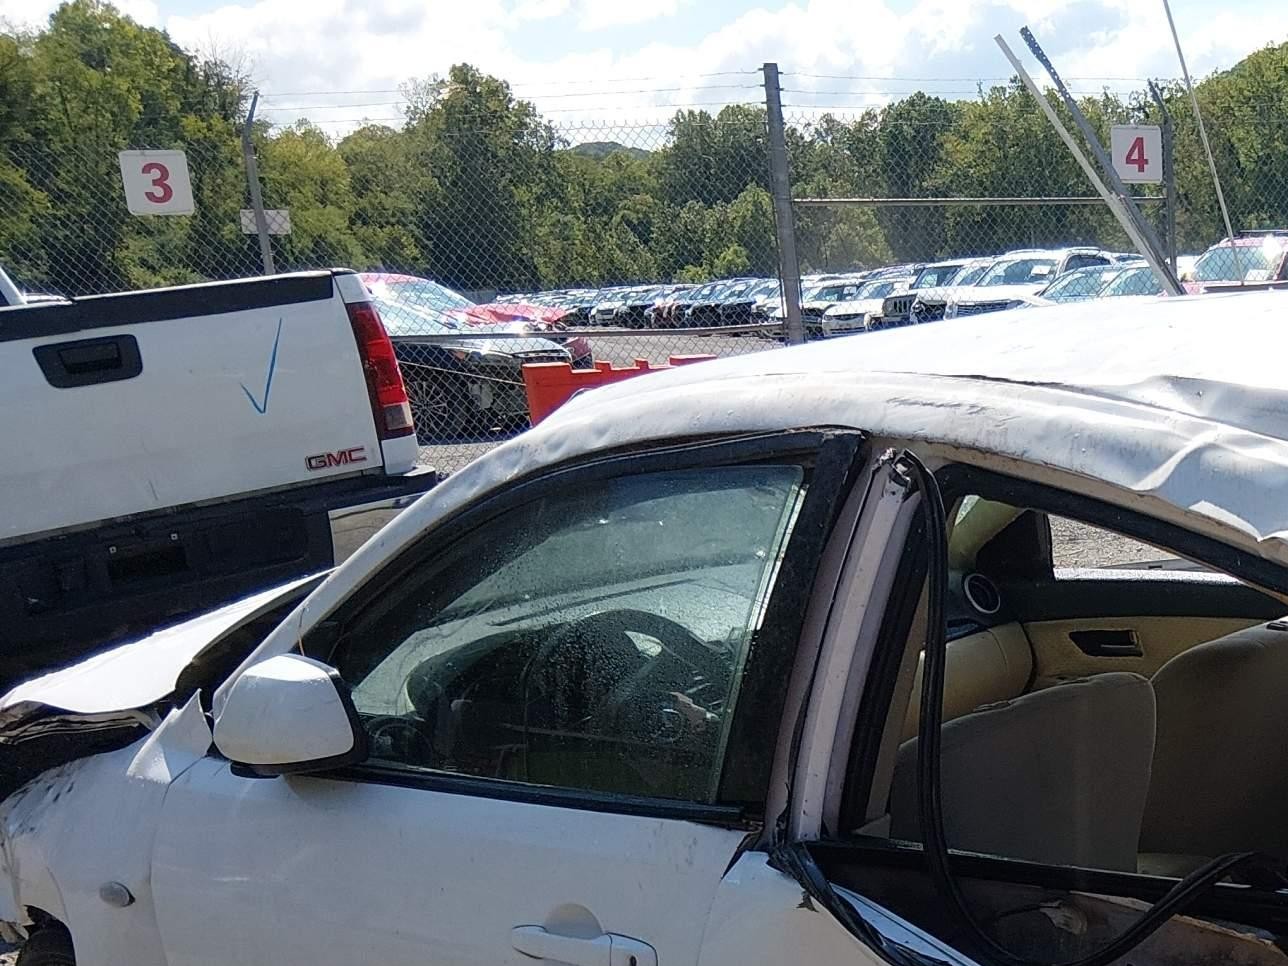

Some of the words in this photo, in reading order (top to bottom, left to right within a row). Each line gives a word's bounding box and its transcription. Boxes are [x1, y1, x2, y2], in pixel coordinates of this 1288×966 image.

[1125, 136, 1149, 173] 4
[141, 162, 174, 204] 3
[305, 445, 367, 471] GMC
